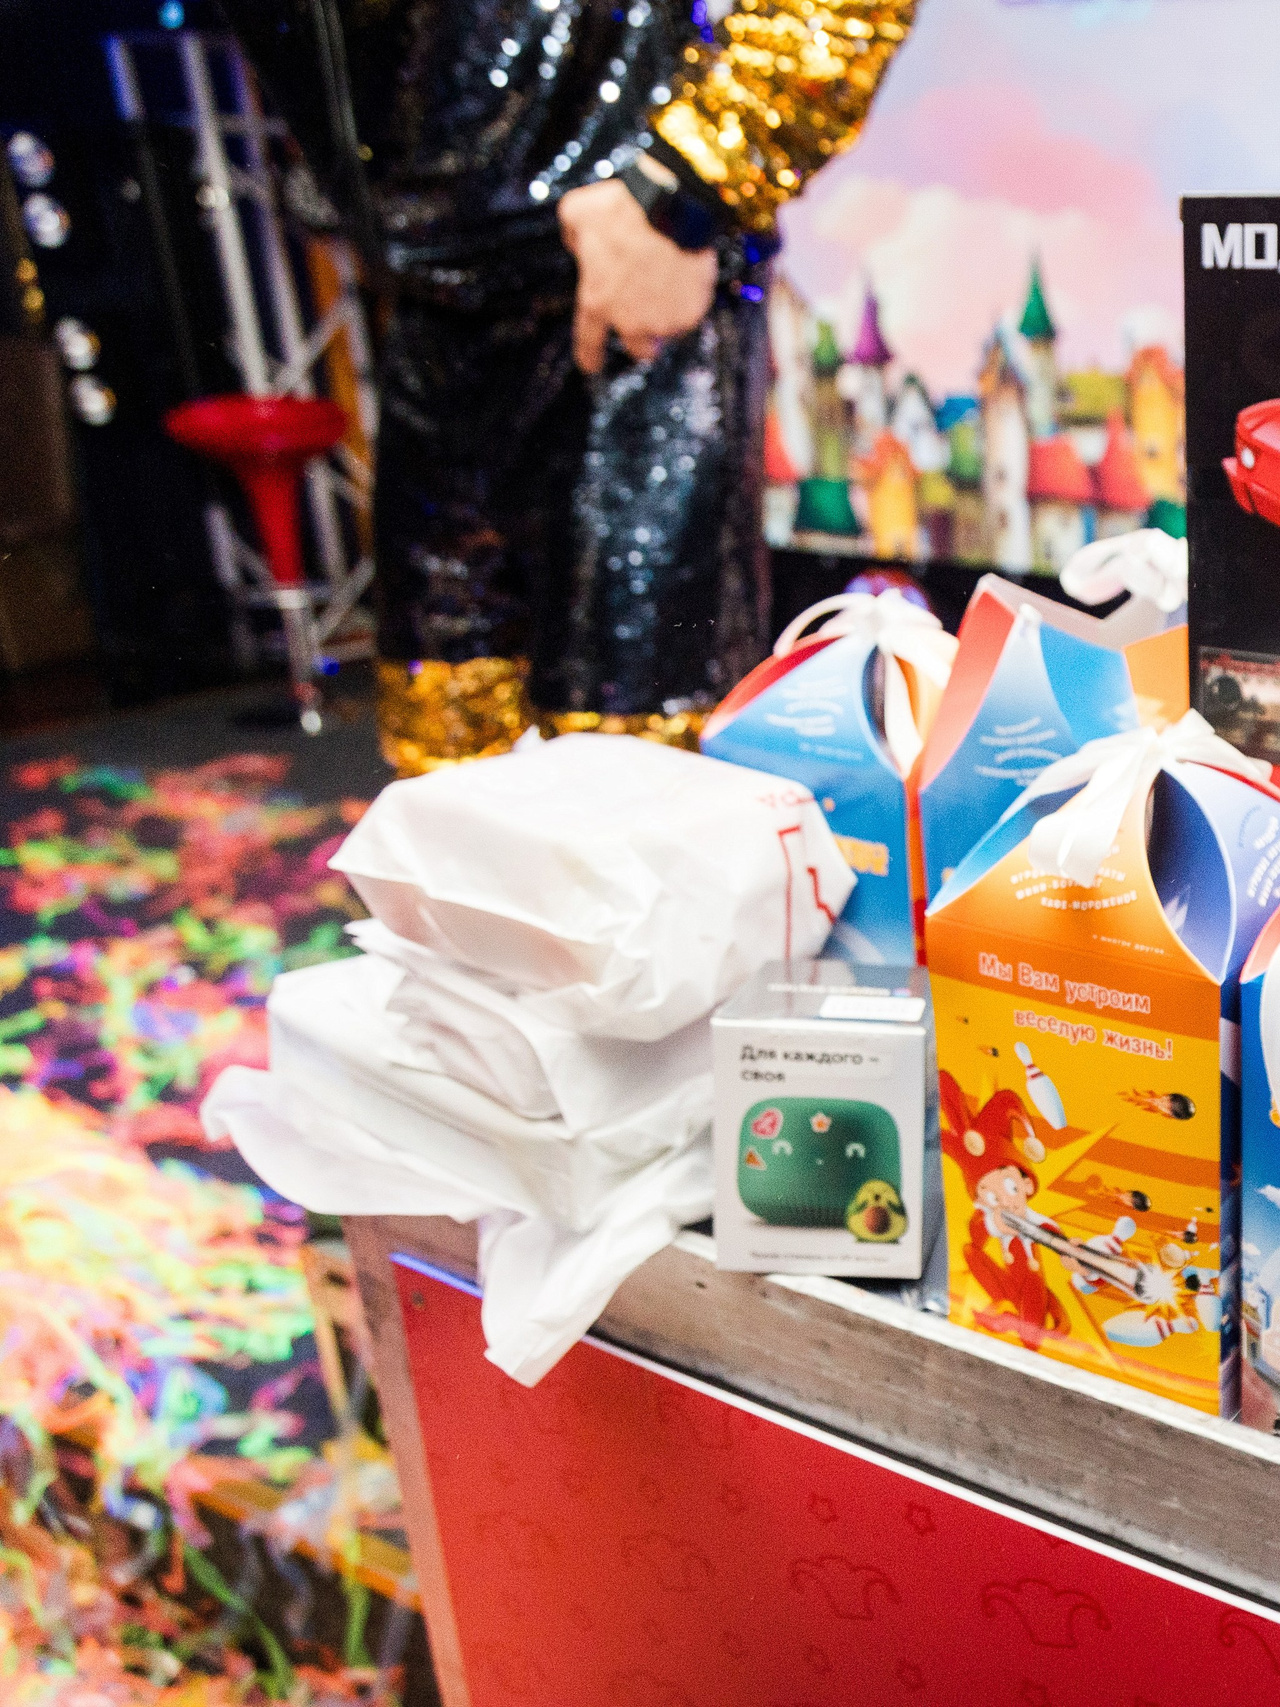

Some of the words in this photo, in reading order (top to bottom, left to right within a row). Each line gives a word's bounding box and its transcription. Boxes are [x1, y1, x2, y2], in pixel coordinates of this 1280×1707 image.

[977, 952, 1013, 982] Мы
[1017, 961, 1060, 992] Вам
[1065, 976, 1151, 1014] устроим
[1013, 1009, 1097, 1044] веселую
[1102, 1028, 1173, 1062] жизнь!
[739, 1043, 778, 1062] Для
[781, 1048, 864, 1067] каждого
[740, 1068, 786, 1084] своя
